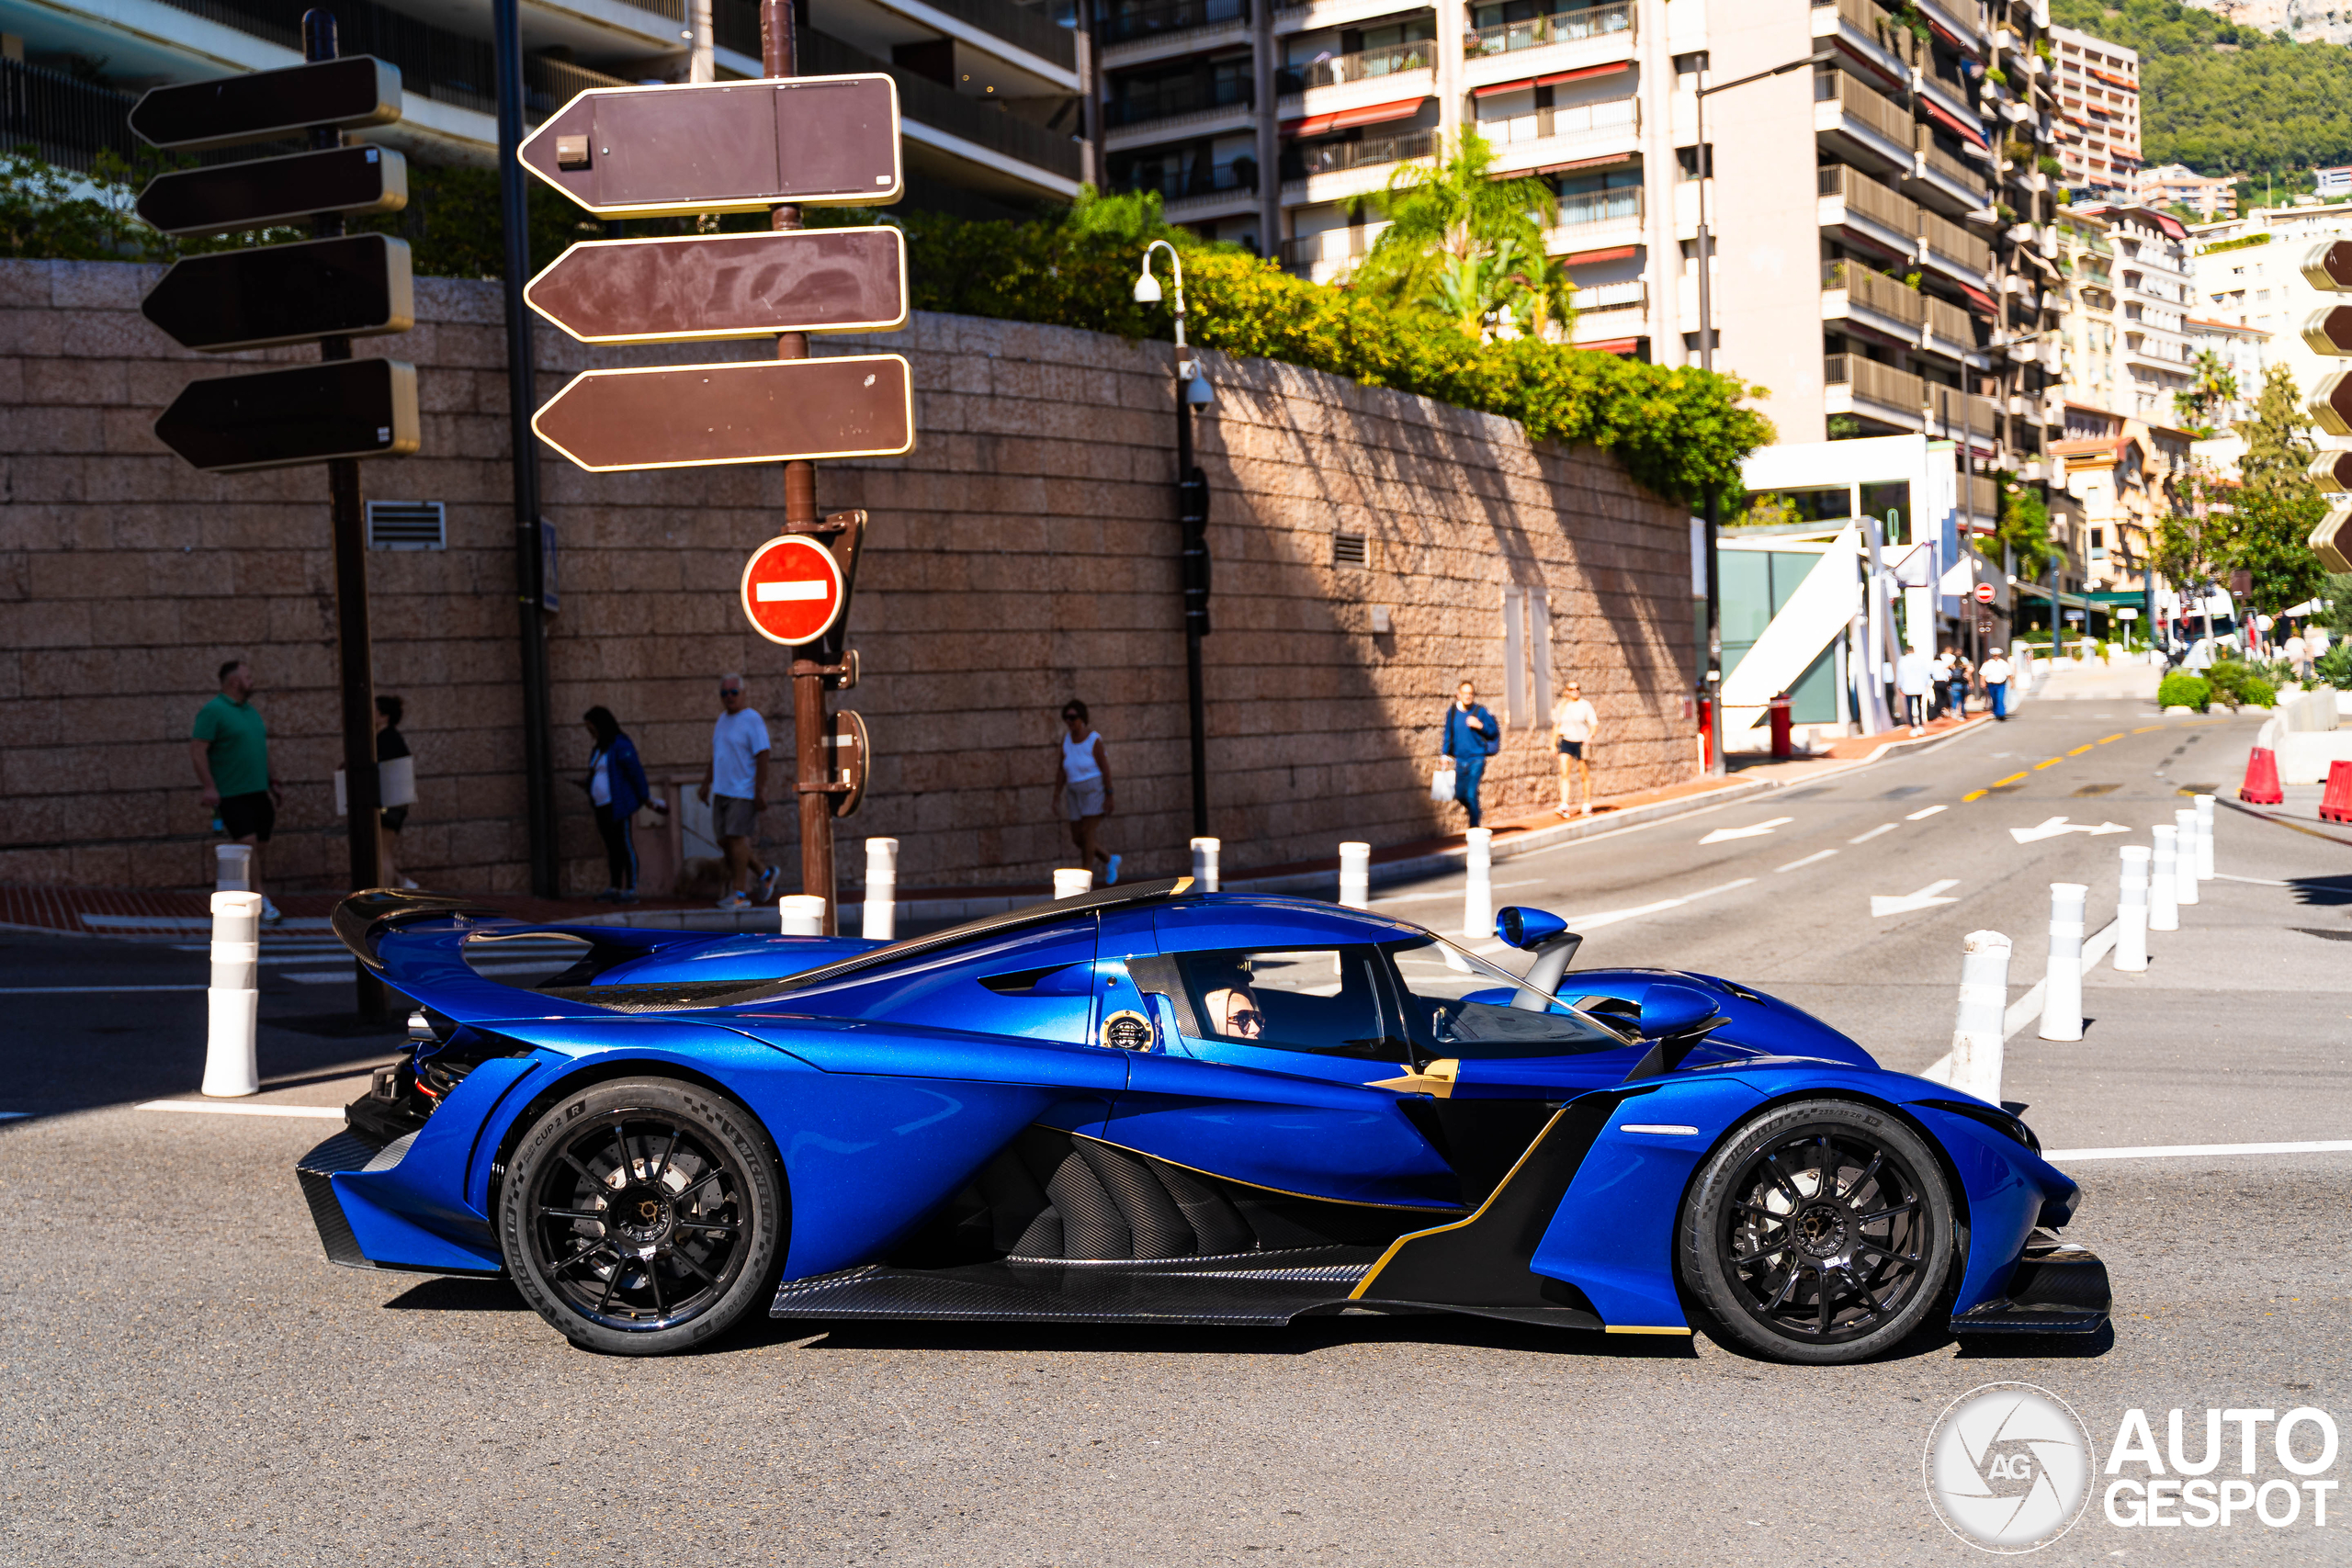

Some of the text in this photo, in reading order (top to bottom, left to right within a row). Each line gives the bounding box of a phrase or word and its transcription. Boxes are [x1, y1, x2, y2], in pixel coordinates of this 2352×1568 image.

[535, 1105, 581, 1146] CUP 2 R
[1818, 1109, 1849, 1117] 235/35
[524, 1144, 535, 1161] PILOT
[526, 1148, 537, 1164] SPORT
[1724, 1119, 1781, 1170] MICHELIN
[737, 1142, 772, 1228] MICHELIN
[506, 1212, 541, 1298] MICHELIN
[697, 1278, 754, 1335] 305/30 ZR 19
